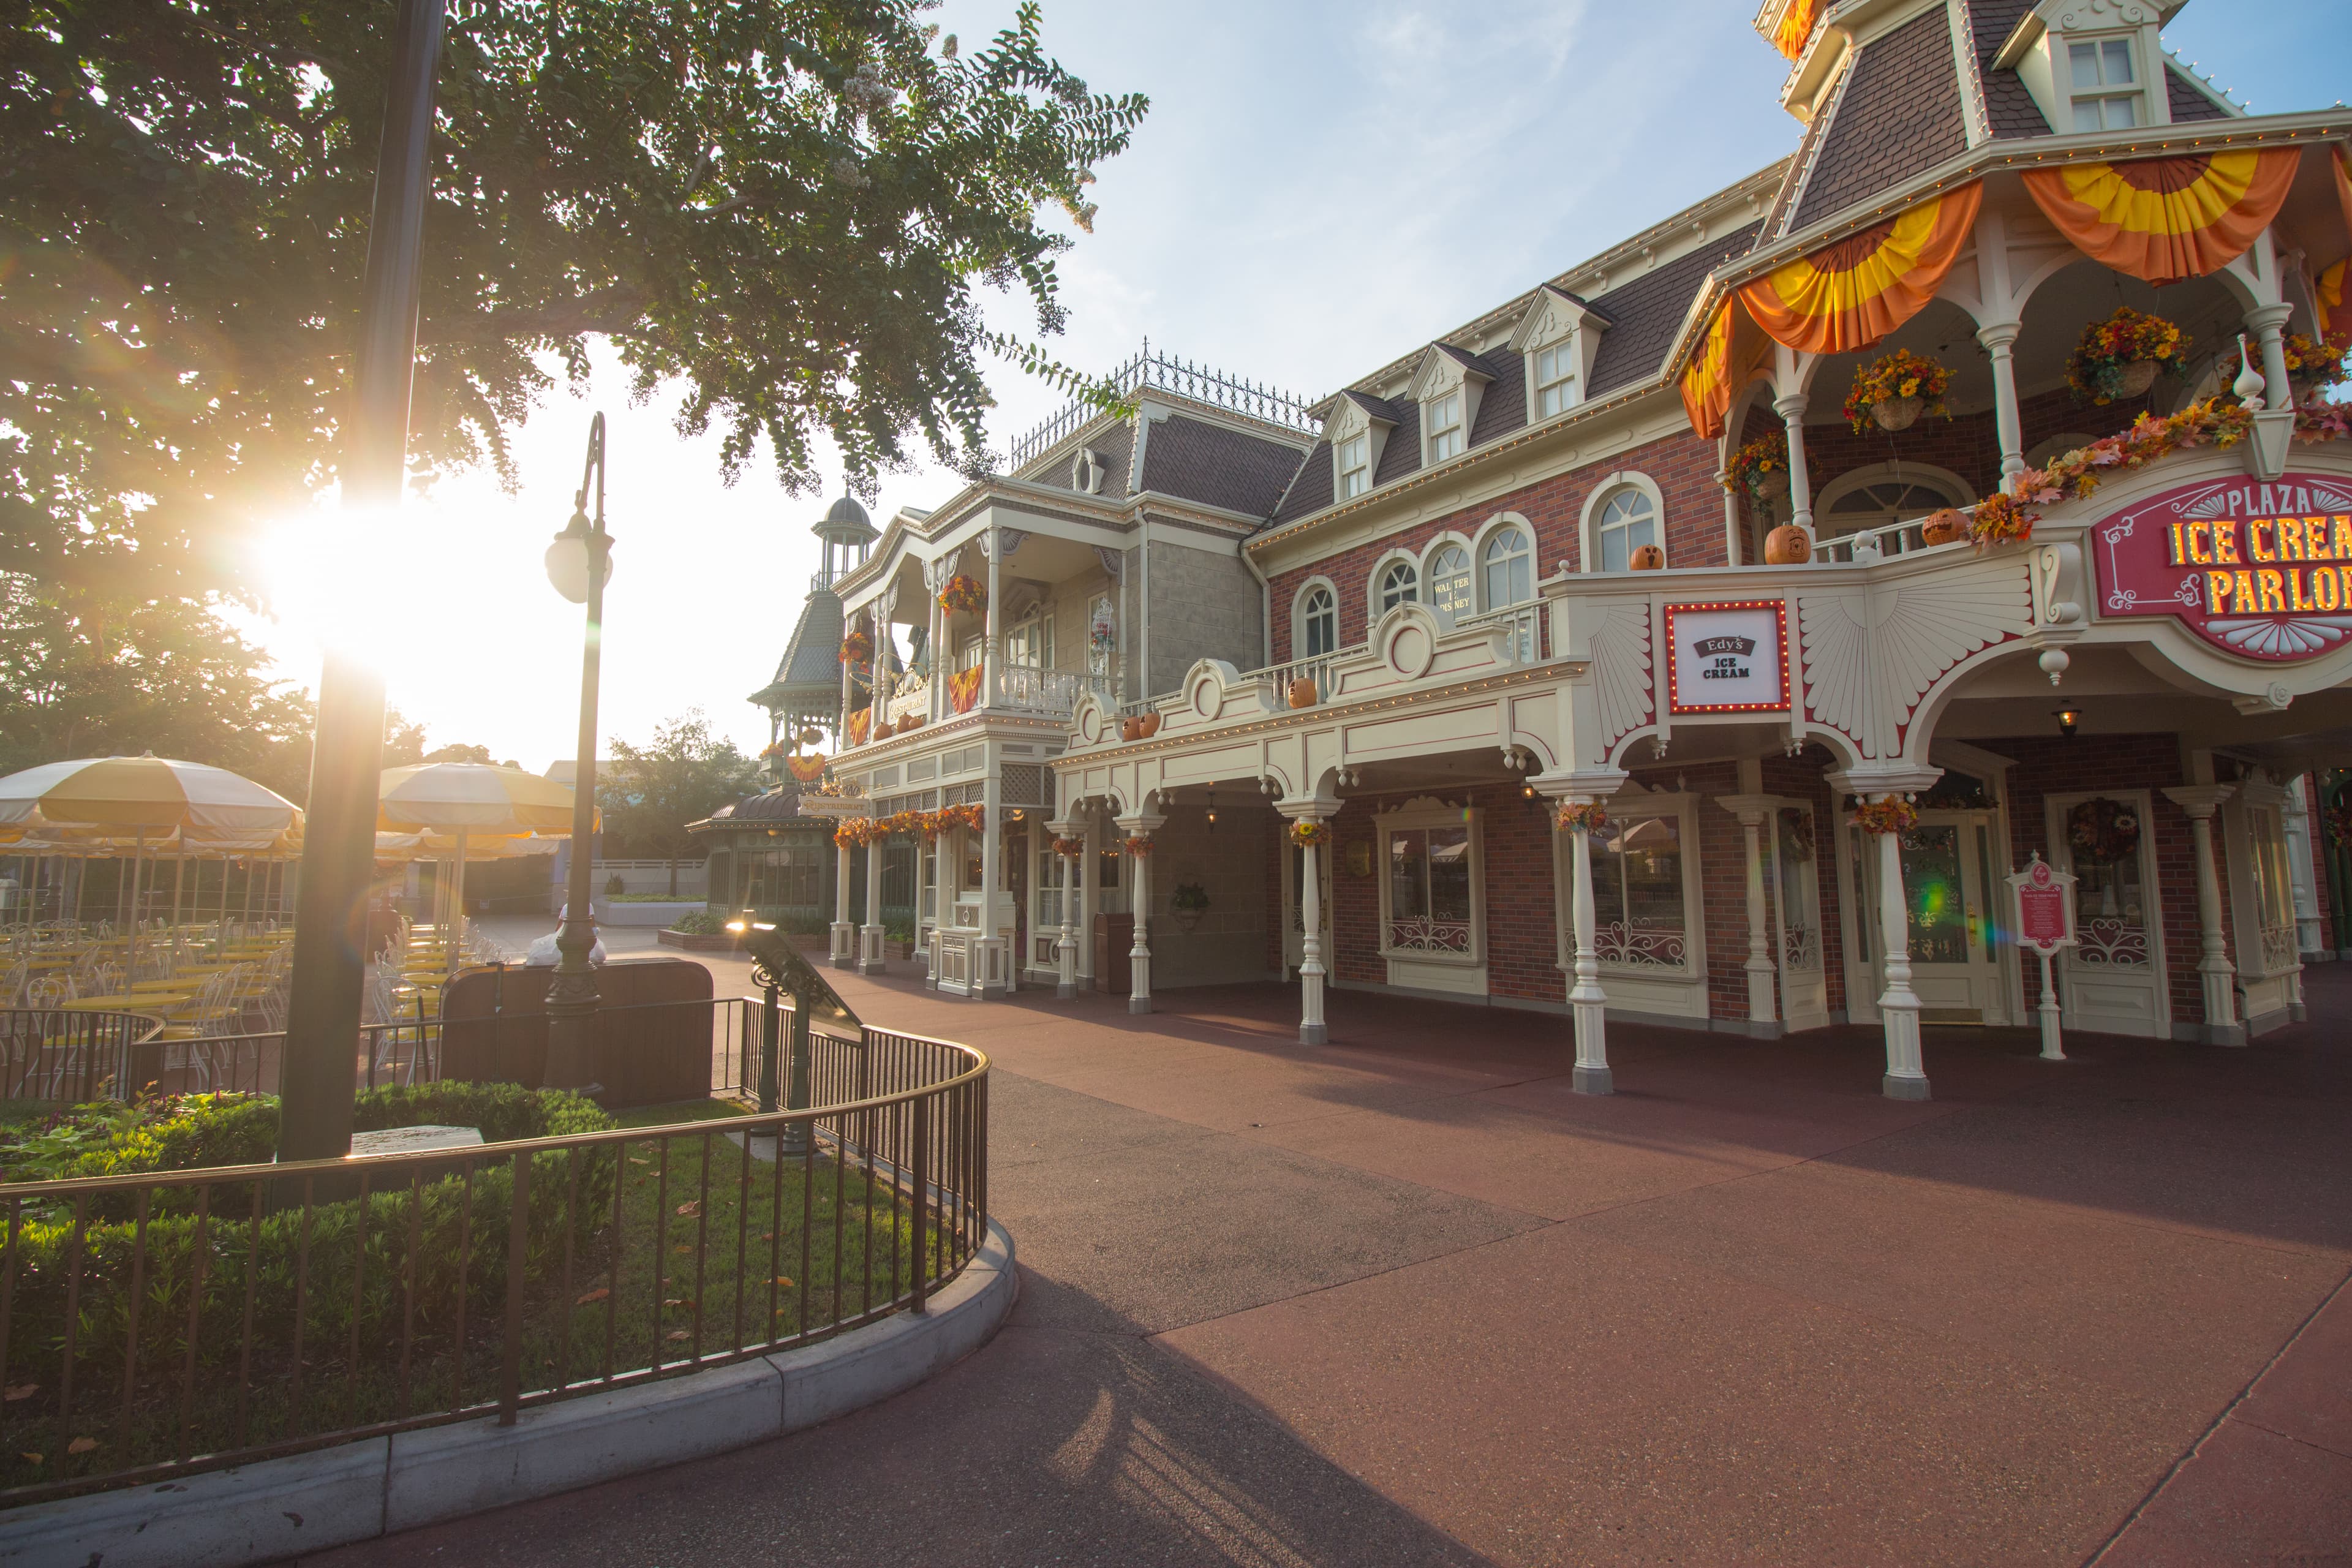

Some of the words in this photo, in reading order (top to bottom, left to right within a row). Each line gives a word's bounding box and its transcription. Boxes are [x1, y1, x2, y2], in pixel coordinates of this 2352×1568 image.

[2228, 484, 2312, 516] PLAZA
[2167, 521, 2241, 567] ICE
[1434, 577, 1469, 594] WALTER
[1706, 637, 1744, 652] Edy's
[1714, 658, 1736, 668] ICE
[1703, 668, 1750, 679] CREAM
